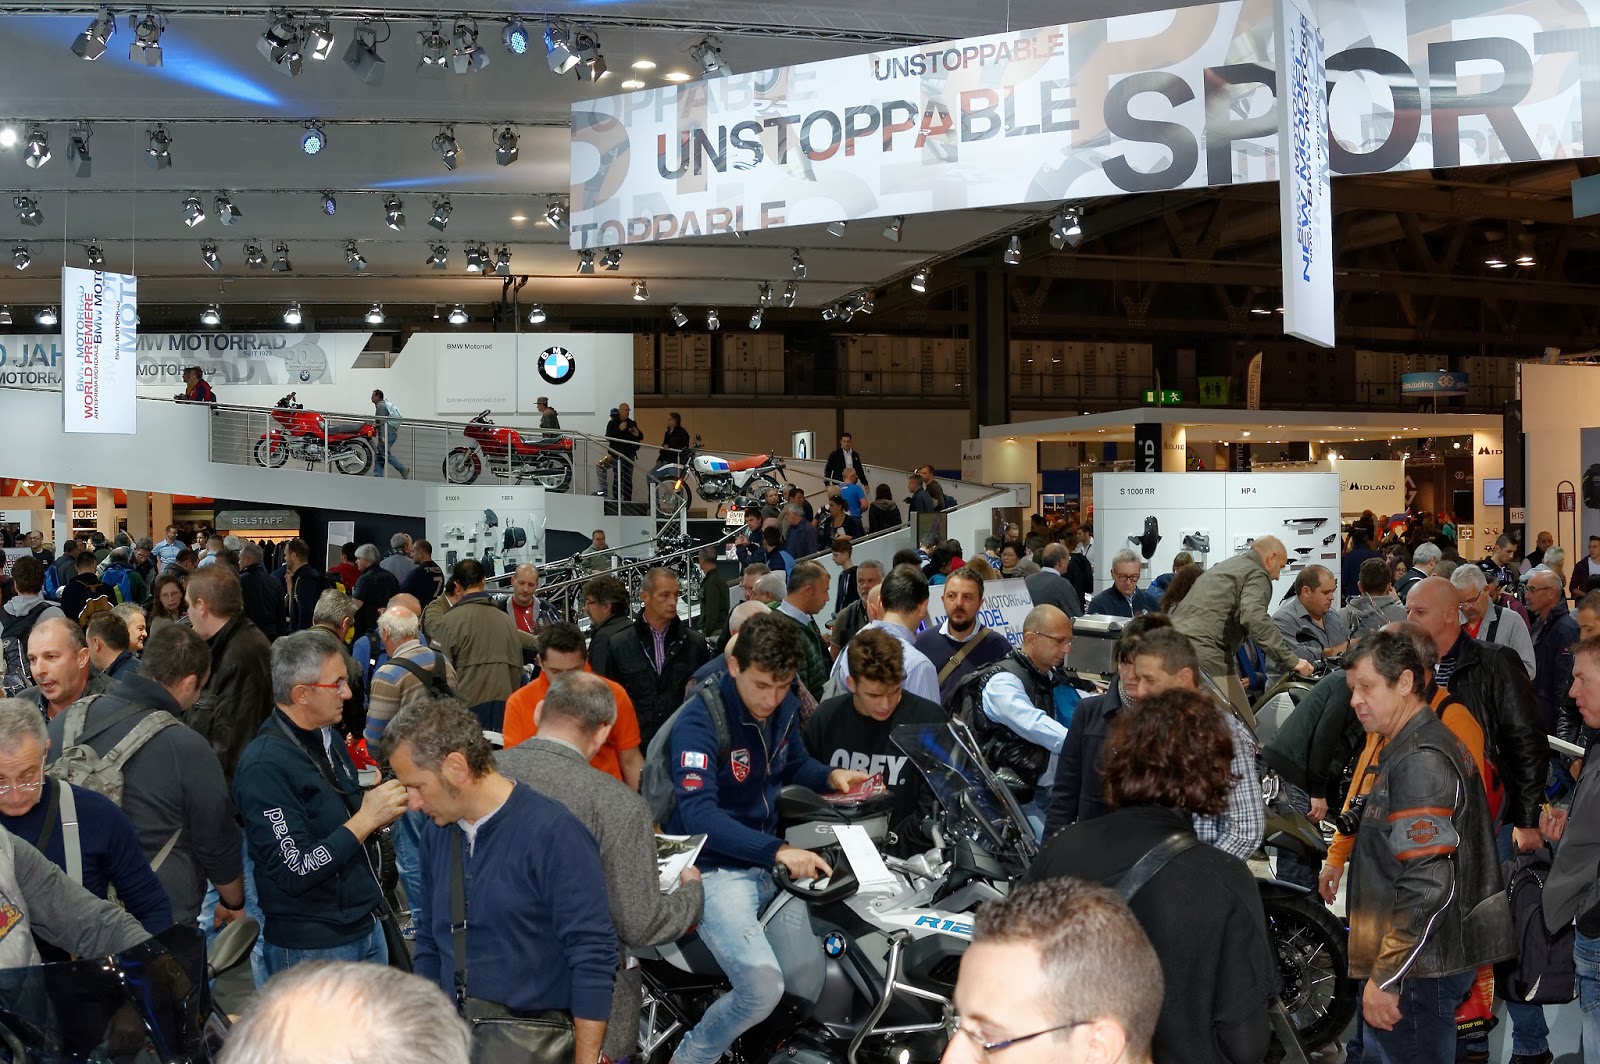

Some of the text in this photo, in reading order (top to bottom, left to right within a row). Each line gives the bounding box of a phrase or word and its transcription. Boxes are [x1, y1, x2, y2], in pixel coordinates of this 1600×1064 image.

[873, 33, 1064, 82] UNSTOPPABLE
[657, 79, 1080, 180] UNSTOPPABLE
[1101, 26, 1600, 192] SPORT
[1295, 55, 1310, 282] NEW MODEL
[76, 285, 84, 358] MOTORRAD
[94, 309, 103, 344] BMW
[168, 334, 287, 351] MOTORRAD
[84, 292, 93, 419] WORLD PREMIERE
[1349, 482, 1396, 491] MIDLAND
[232, 517, 283, 525] BELSTAFF
[1511, 512, 1524, 521] H15
[983, 592, 1032, 610] MOTORRAD
